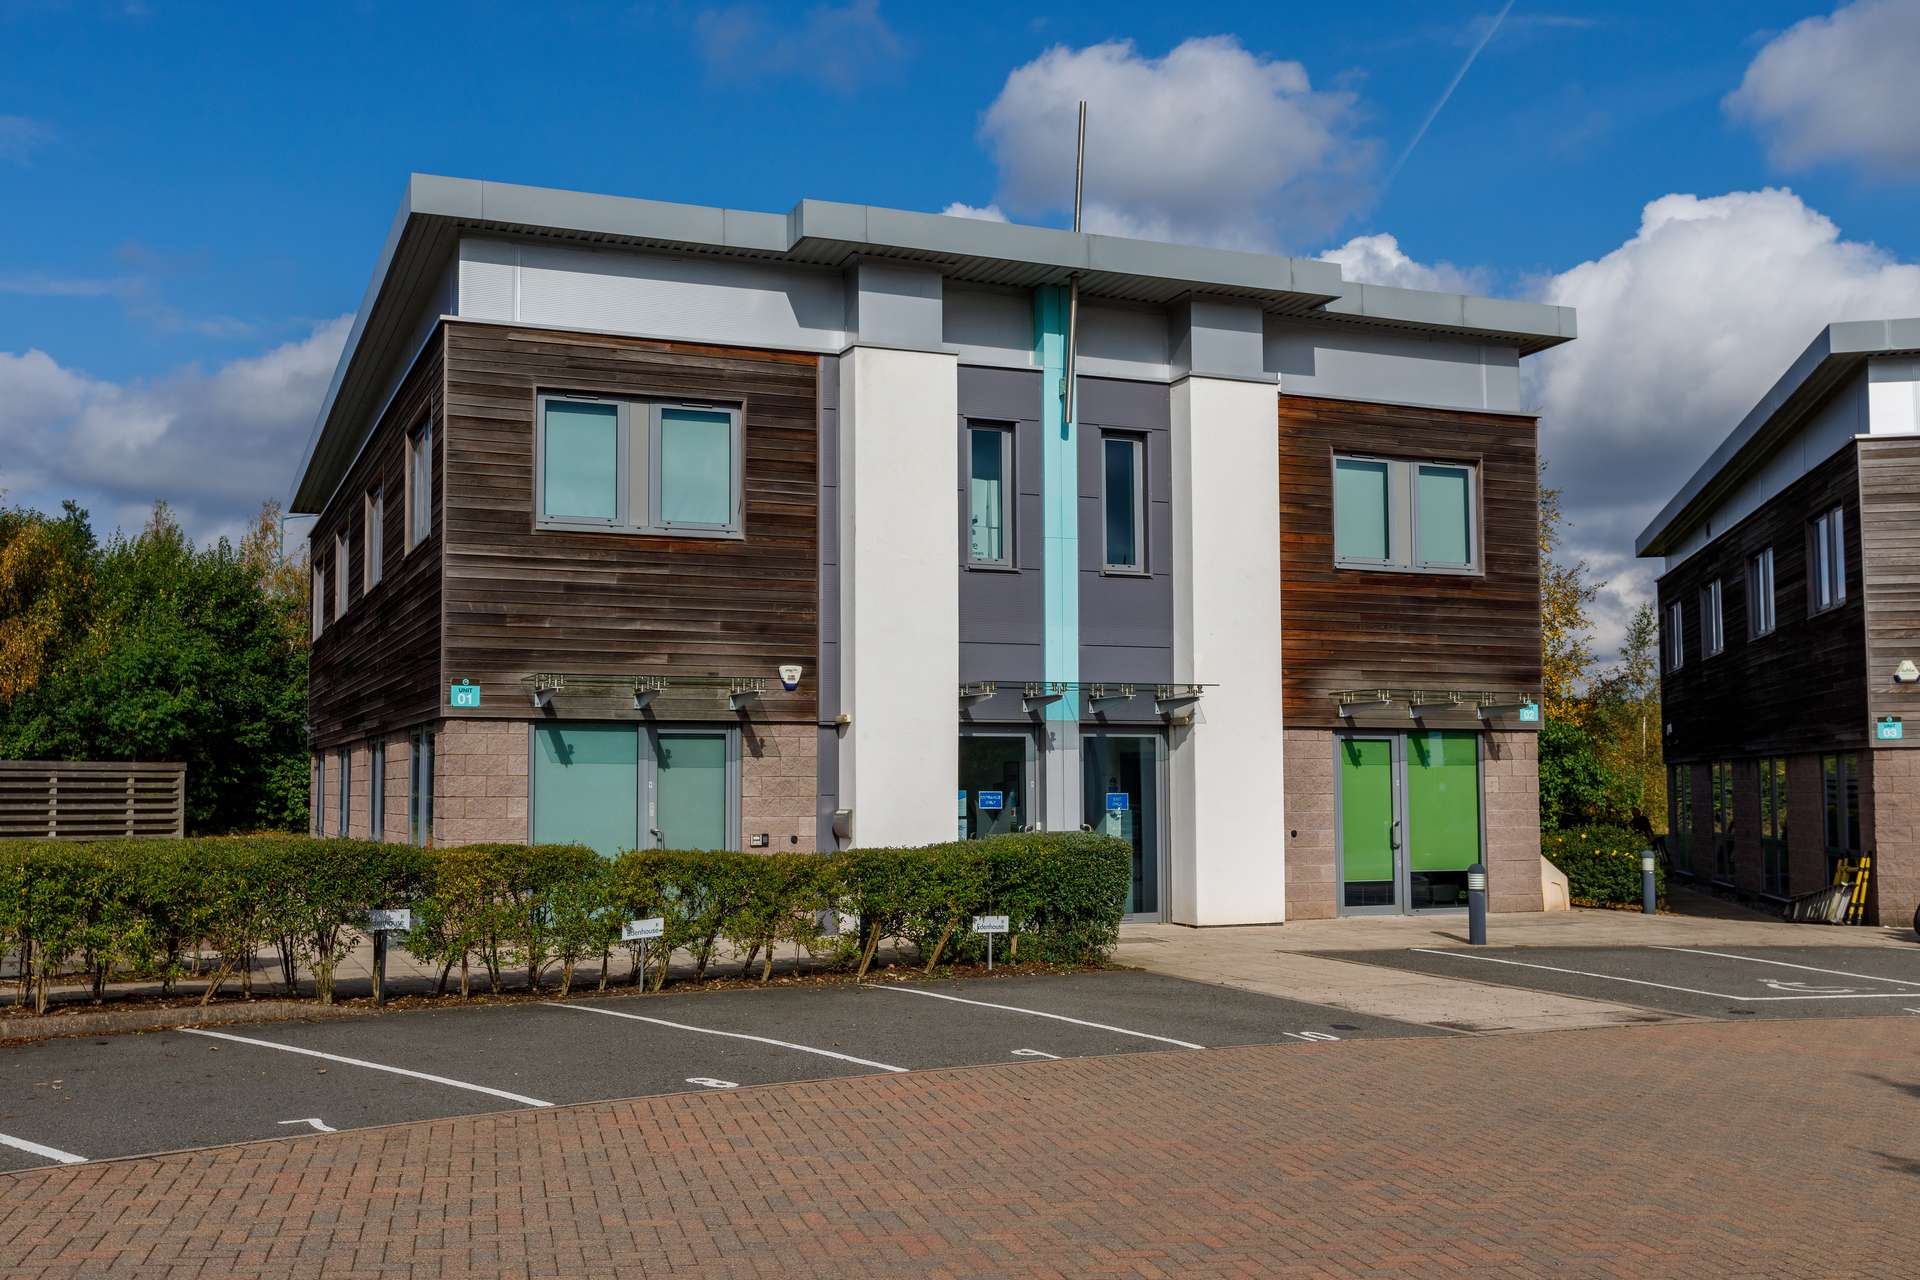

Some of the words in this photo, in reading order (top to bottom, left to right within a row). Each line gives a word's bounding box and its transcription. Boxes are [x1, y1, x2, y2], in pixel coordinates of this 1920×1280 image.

[457, 693, 472, 705] 01
[1523, 710, 1535, 721] 02
[627, 928, 659, 937] Edenhouse
[685, 1077, 740, 1088] 8
[277, 1118, 337, 1132] 7
